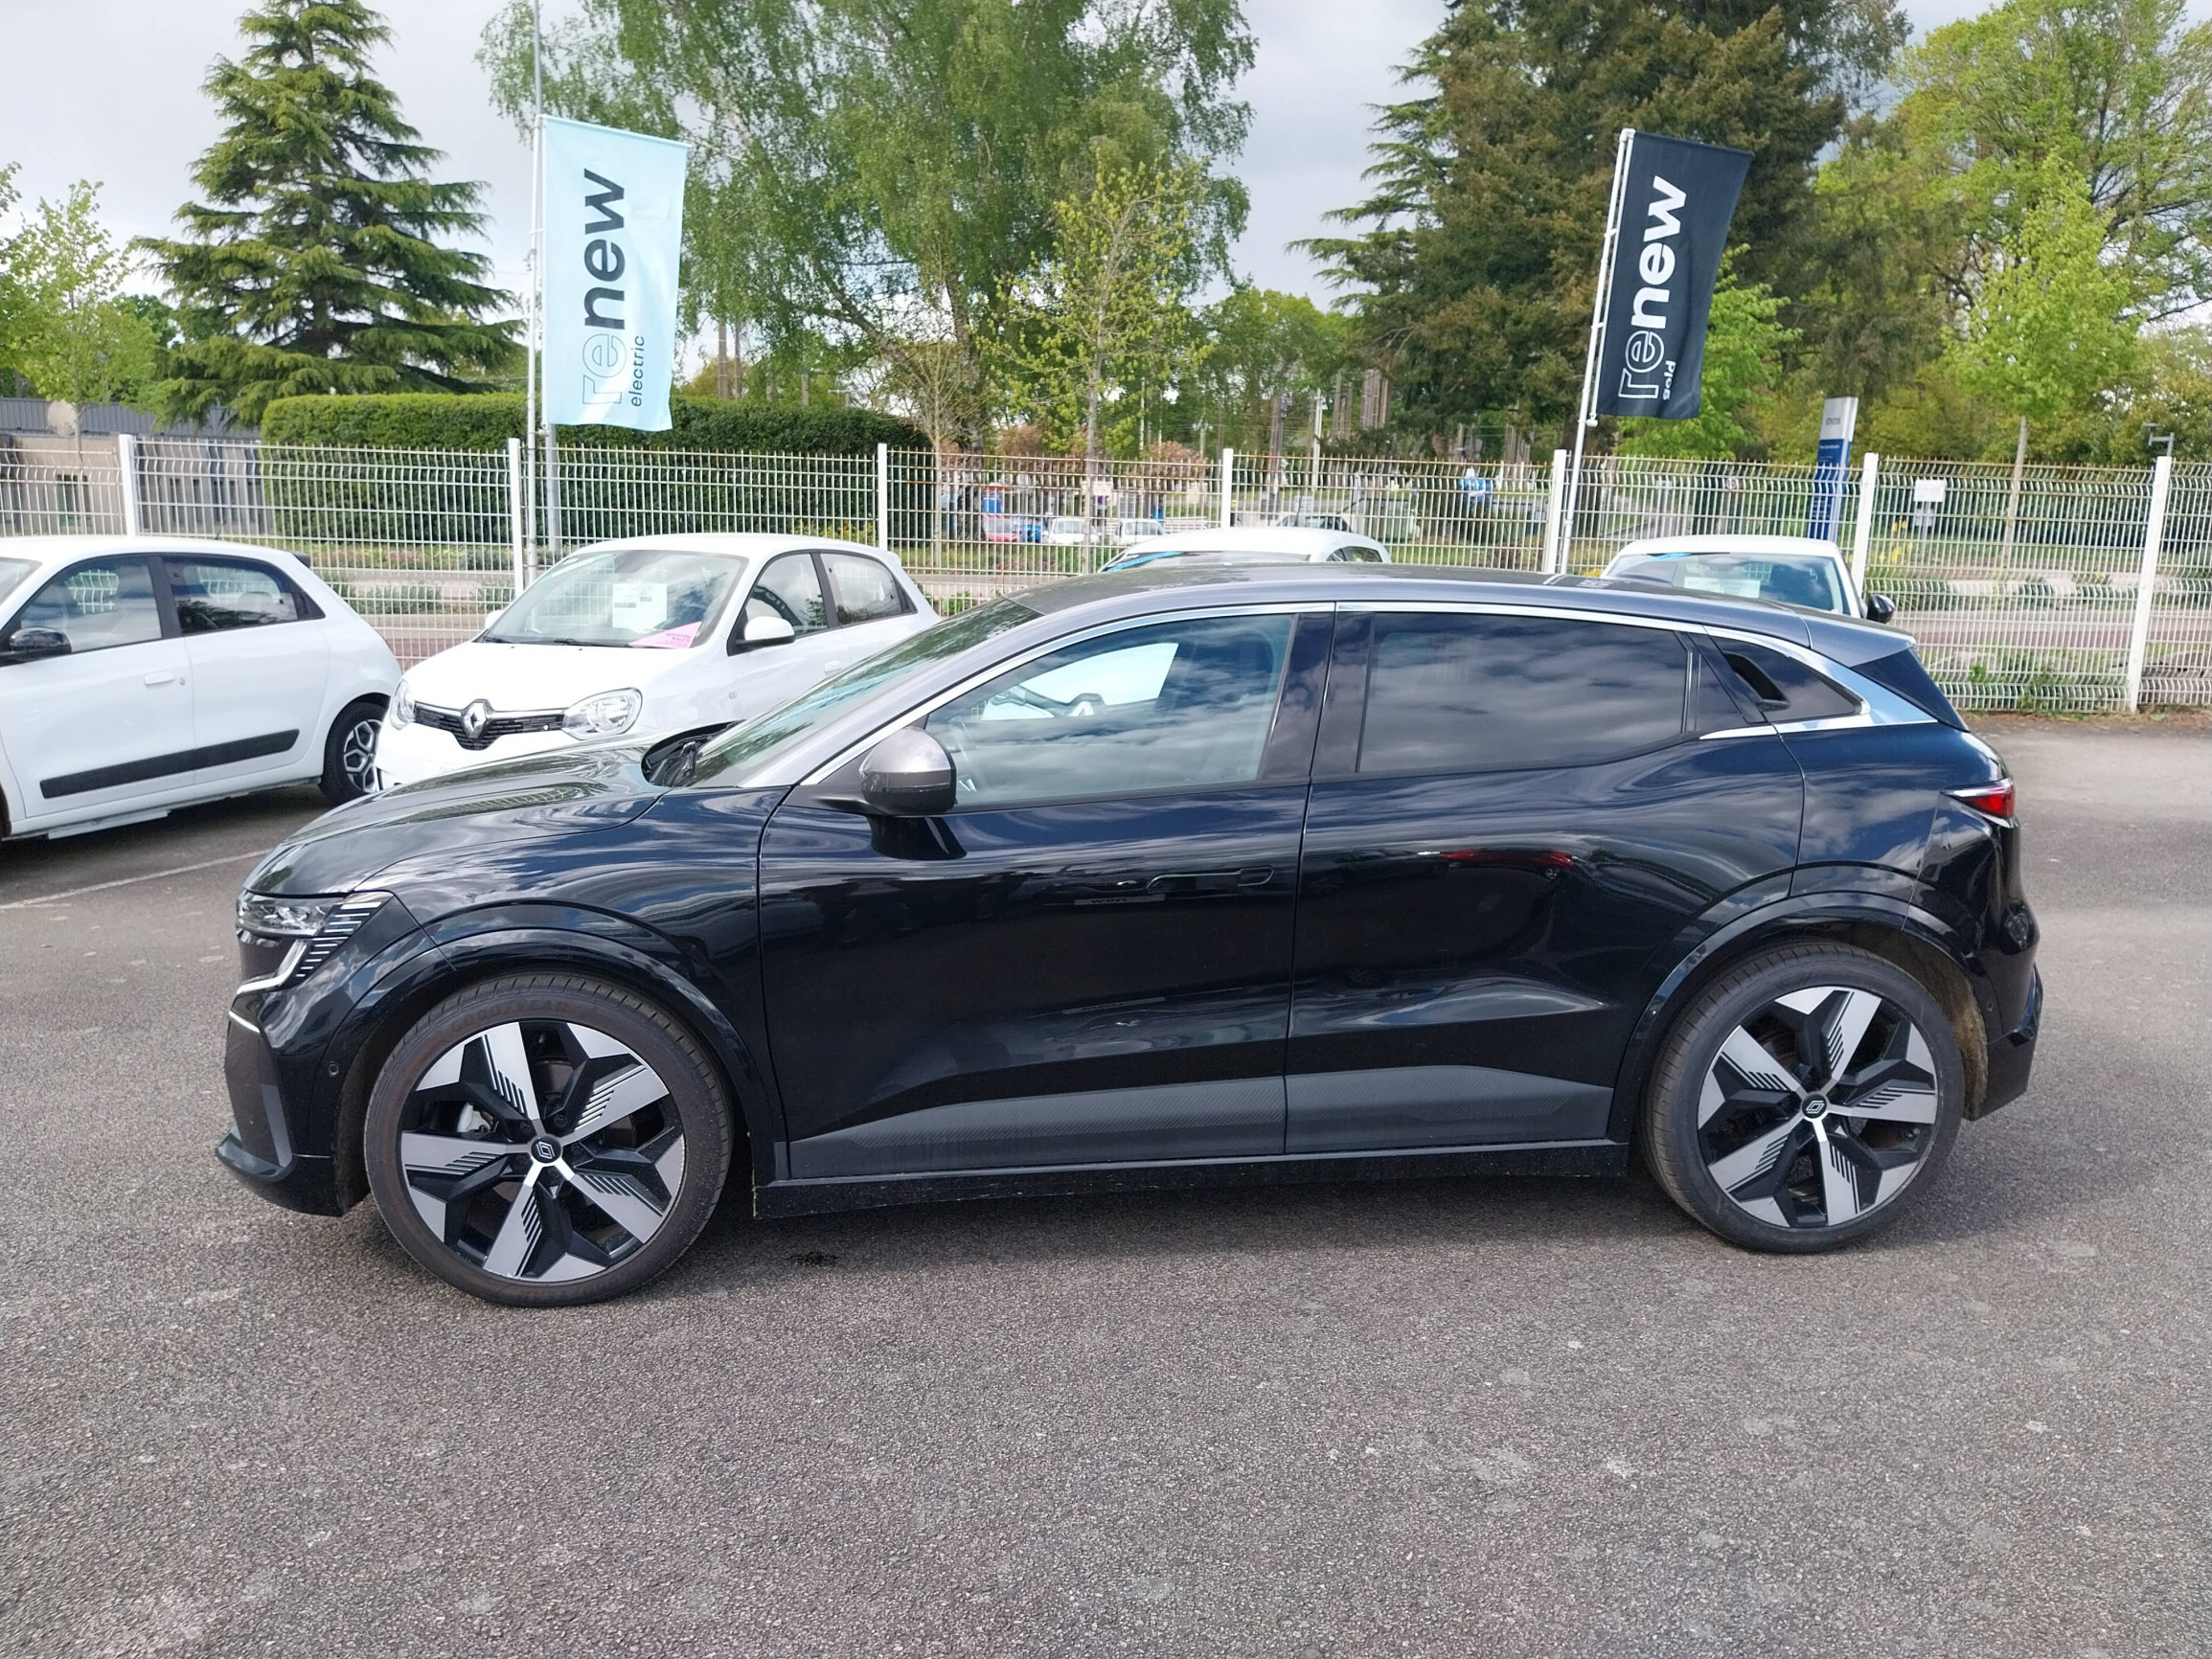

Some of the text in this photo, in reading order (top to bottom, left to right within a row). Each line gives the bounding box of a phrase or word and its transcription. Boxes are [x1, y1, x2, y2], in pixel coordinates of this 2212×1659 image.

[582, 168, 627, 404] renew
[1618, 175, 1687, 398] renew
[629, 335, 646, 407] electric
[1662, 360, 1676, 400] gold
